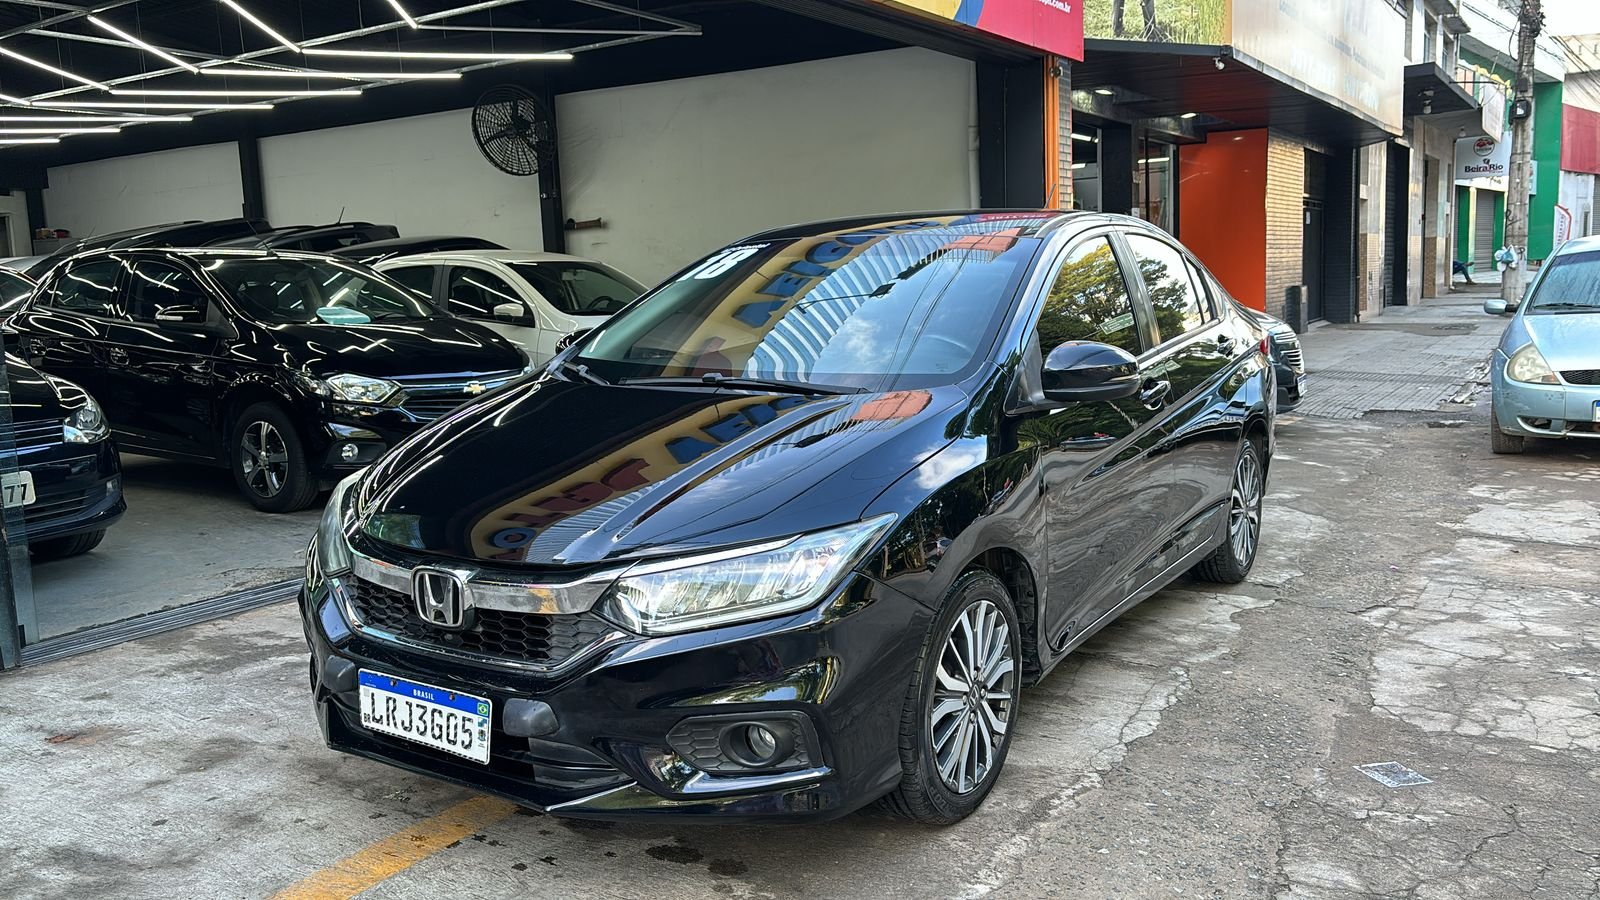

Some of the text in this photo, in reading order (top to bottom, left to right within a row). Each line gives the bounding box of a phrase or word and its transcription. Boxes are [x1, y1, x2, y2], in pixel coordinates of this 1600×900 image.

[1489, 163, 1504, 171] Rio
[675, 248, 760, 282] 18
[3, 483, 27, 503] 77
[413, 689, 434, 701] BRASIL
[363, 713, 372, 724] BR
[371, 692, 474, 750] LRJ3G05
